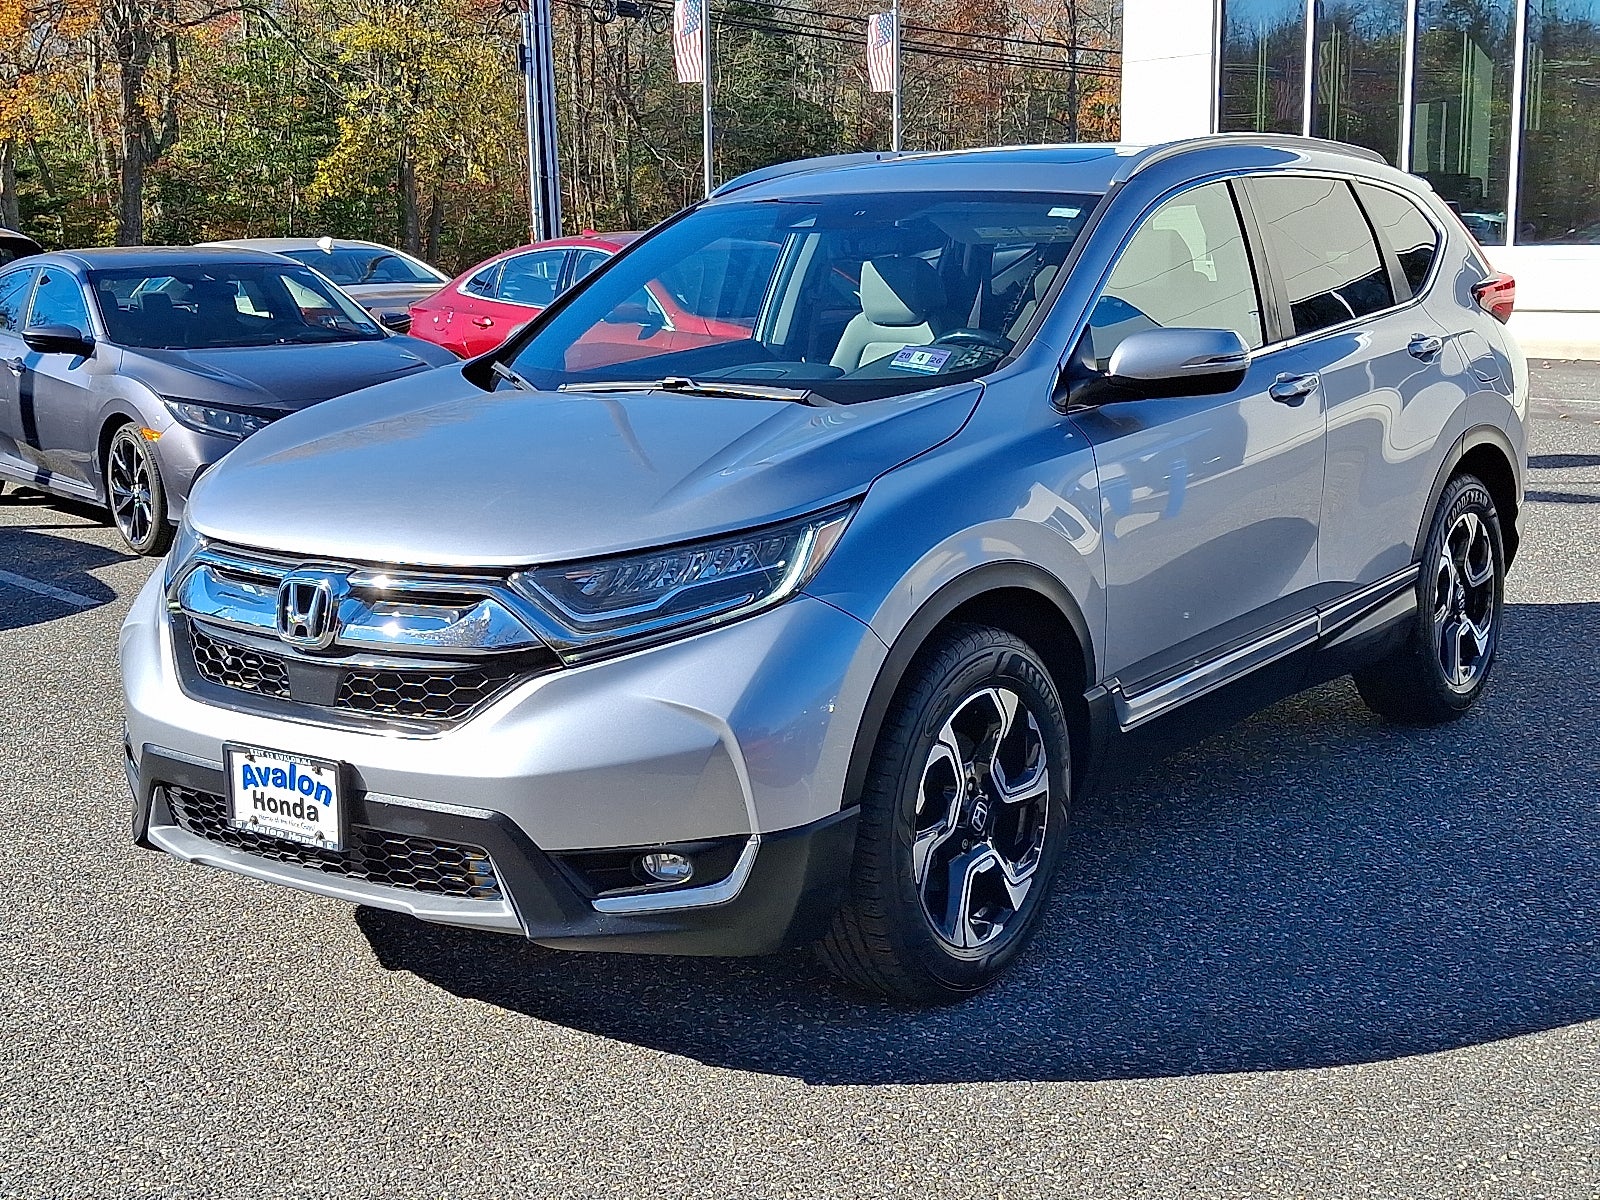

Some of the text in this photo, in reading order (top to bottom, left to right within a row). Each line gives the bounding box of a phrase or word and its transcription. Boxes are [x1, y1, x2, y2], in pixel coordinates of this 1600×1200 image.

[898, 351, 911, 360] 20
[917, 353, 925, 362] 4
[931, 356, 942, 364] 26
[1447, 490, 1488, 528] GOODYEAR
[242, 762, 333, 807] Avalon
[252, 790, 319, 822] Honda
[245, 821, 324, 848] Avalon Honda
